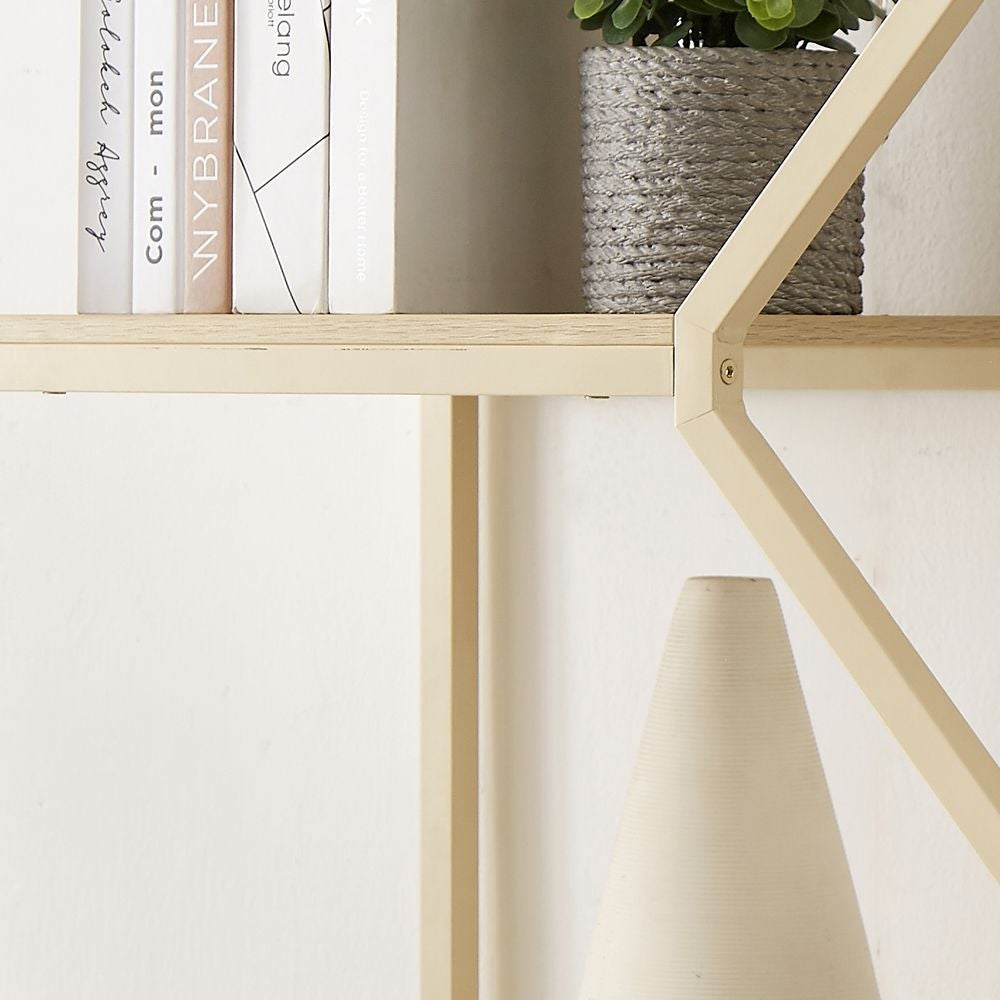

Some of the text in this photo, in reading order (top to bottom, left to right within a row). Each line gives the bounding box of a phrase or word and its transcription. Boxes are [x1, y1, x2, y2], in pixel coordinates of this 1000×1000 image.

[150, 70, 164, 136] mon
[85, 141, 121, 253] Aggrey
[146, 196, 164, 265] Com
